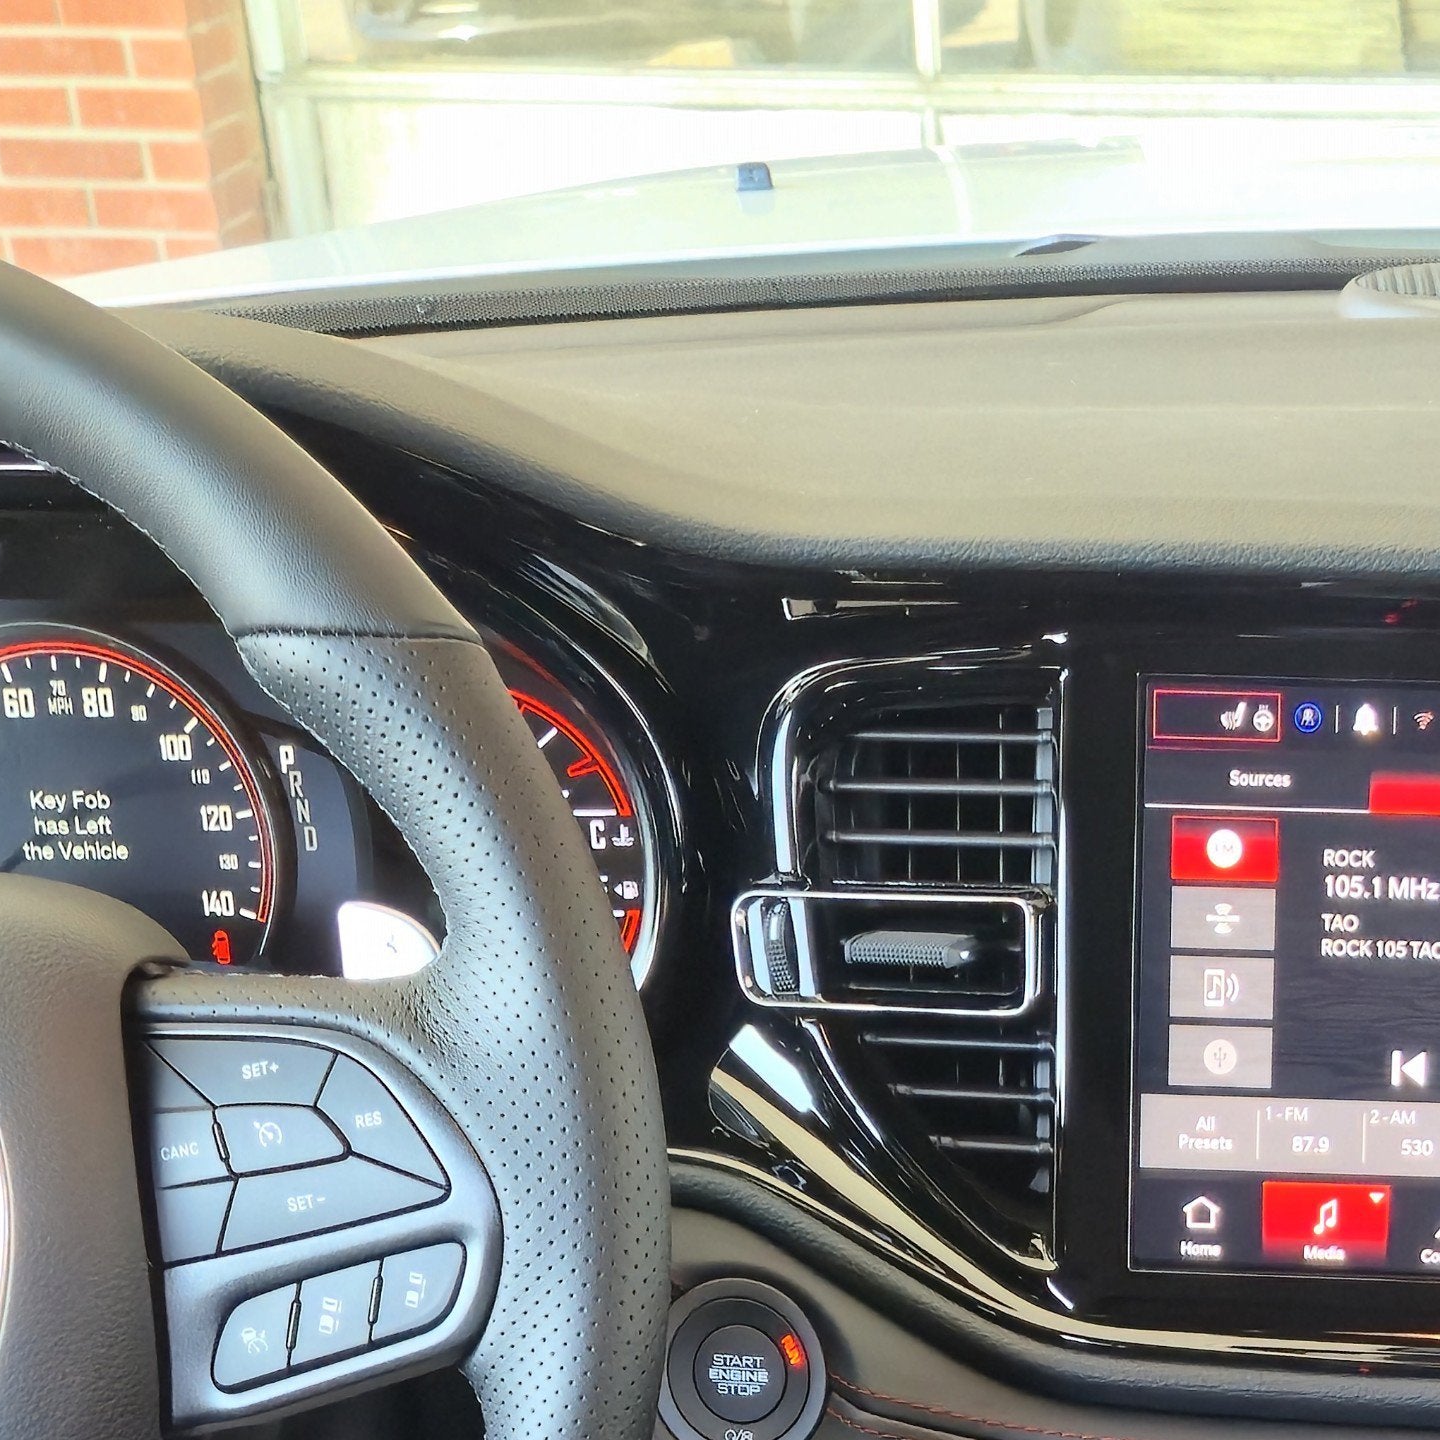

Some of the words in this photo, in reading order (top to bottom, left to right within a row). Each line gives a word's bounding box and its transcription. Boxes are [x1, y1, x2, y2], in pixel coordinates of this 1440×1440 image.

[49, 680, 67, 696] 70
[2, 687, 35, 719] 60
[47, 697, 74, 716] MPH
[82, 687, 115, 718] 80
[130, 704, 148, 722] 90
[159, 734, 193, 762] 100
[279, 745, 296, 775] P
[191, 768, 211, 785] 110
[289, 770, 304, 798] R
[1229, 768, 1292, 789] Sources
[29, 789, 67, 814] Key
[72, 789, 111, 810] Fob
[296, 798, 311, 824] N
[34, 815, 69, 836] has
[75, 815, 112, 836] Left
[199, 804, 234, 832] 120
[304, 825, 319, 852] D
[589, 819, 607, 850] C
[23, 841, 54, 861] the
[58, 841, 130, 861] Vehicle
[1323, 848, 1376, 868] ROCK
[219, 853, 239, 870] 130
[1324, 874, 1383, 900] 105.1
[202, 890, 236, 917] 140
[1321, 913, 1360, 933] TAO
[1321, 938, 1374, 959] ROCK
[1376, 939, 1408, 960] 105
[355, 1111, 383, 1129] RES
[1196, 1117, 1216, 1132] All
[160, 1142, 199, 1162] CANC
[1178, 1133, 1233, 1153] Presets
[1291, 1136, 1330, 1154] 87.9
[1401, 1139, 1435, 1156] 530
[1180, 1240, 1222, 1259] Home
[1303, 1243, 1345, 1262] Media
[713, 1353, 765, 1368] START
[709, 1367, 769, 1383] ENGINE
[717, 1383, 761, 1396] STOP
